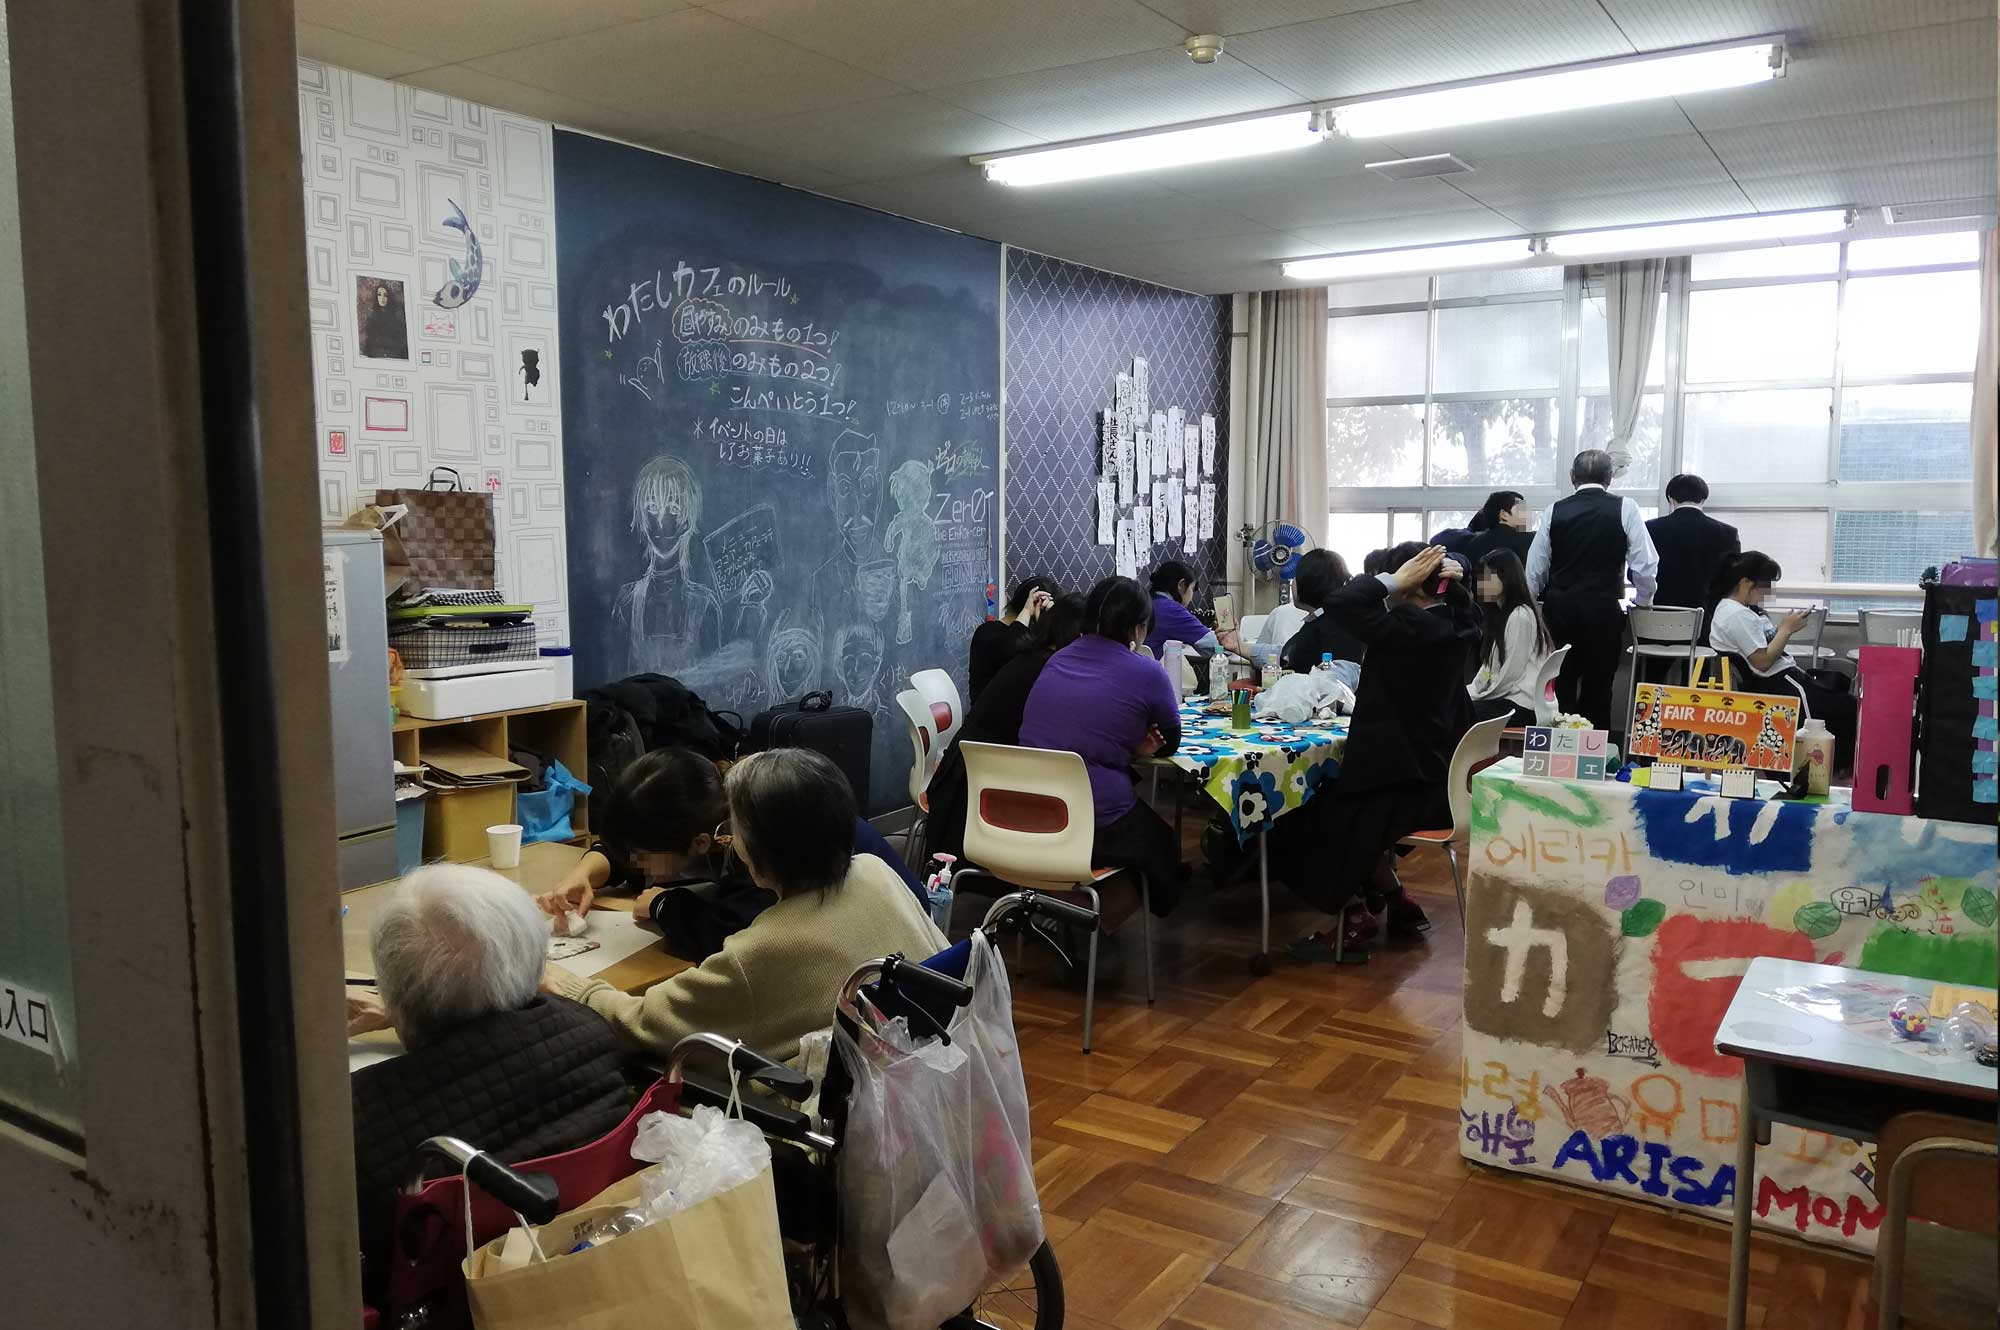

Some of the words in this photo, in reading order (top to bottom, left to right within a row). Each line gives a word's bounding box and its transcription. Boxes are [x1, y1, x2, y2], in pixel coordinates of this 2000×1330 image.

[1663, 705, 1696, 722] FAIR
[1704, 708, 1748, 726] ROAD
[1528, 731, 1601, 751] わたし
[0, 988, 49, 1043] 入口
[1552, 1130, 1737, 1206] ARISA
